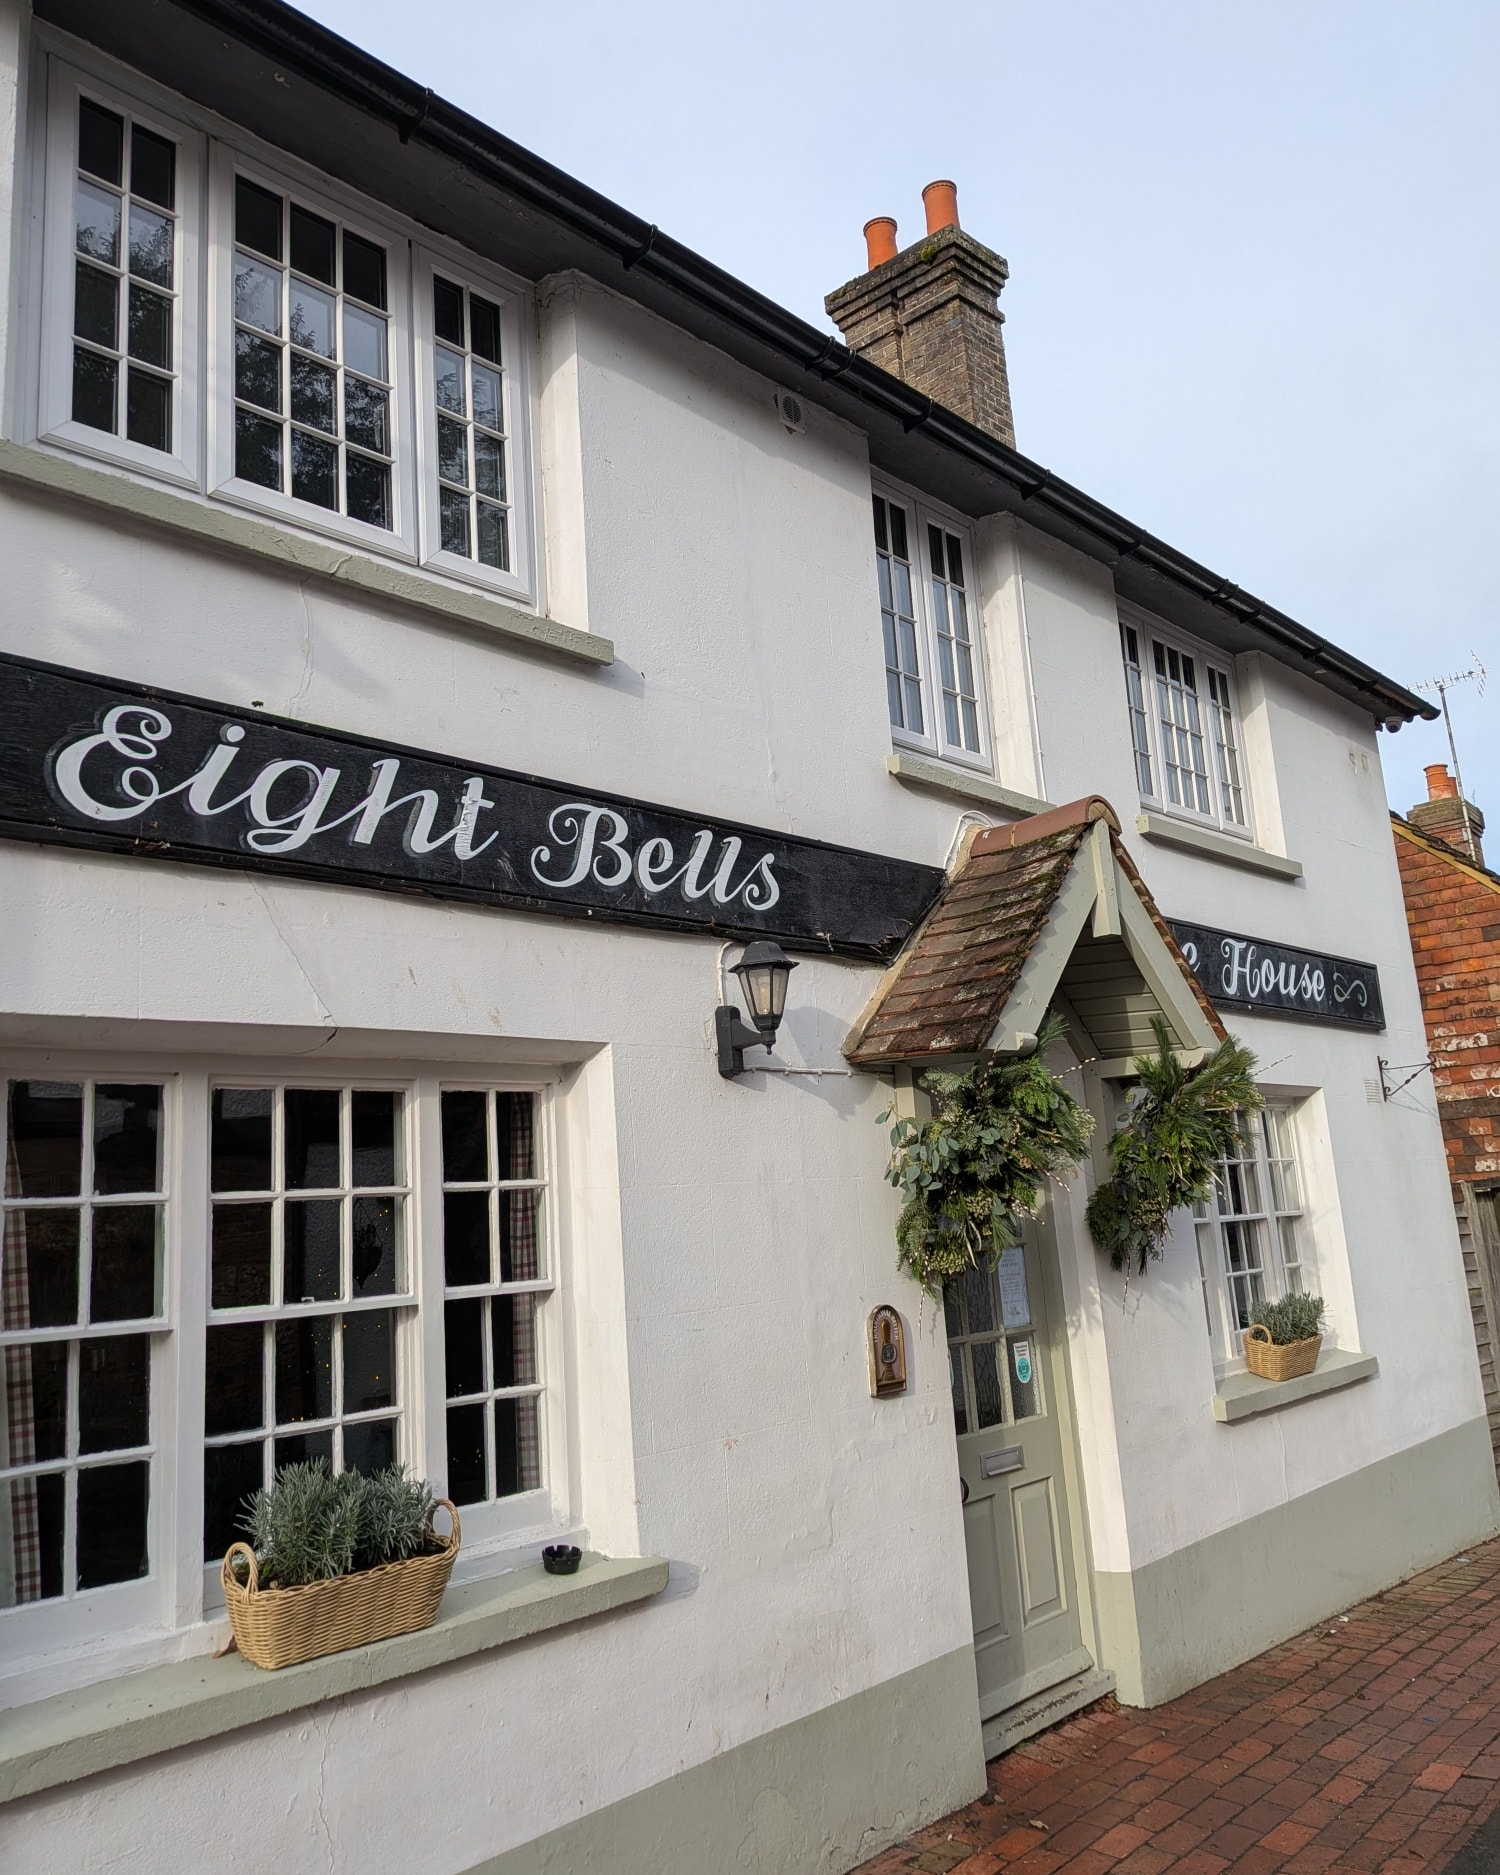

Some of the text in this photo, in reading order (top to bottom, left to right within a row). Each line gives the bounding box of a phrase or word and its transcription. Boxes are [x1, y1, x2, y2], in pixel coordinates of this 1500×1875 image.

[56, 705, 780, 911] Eight Bells
[1221, 938, 1326, 1002] House
